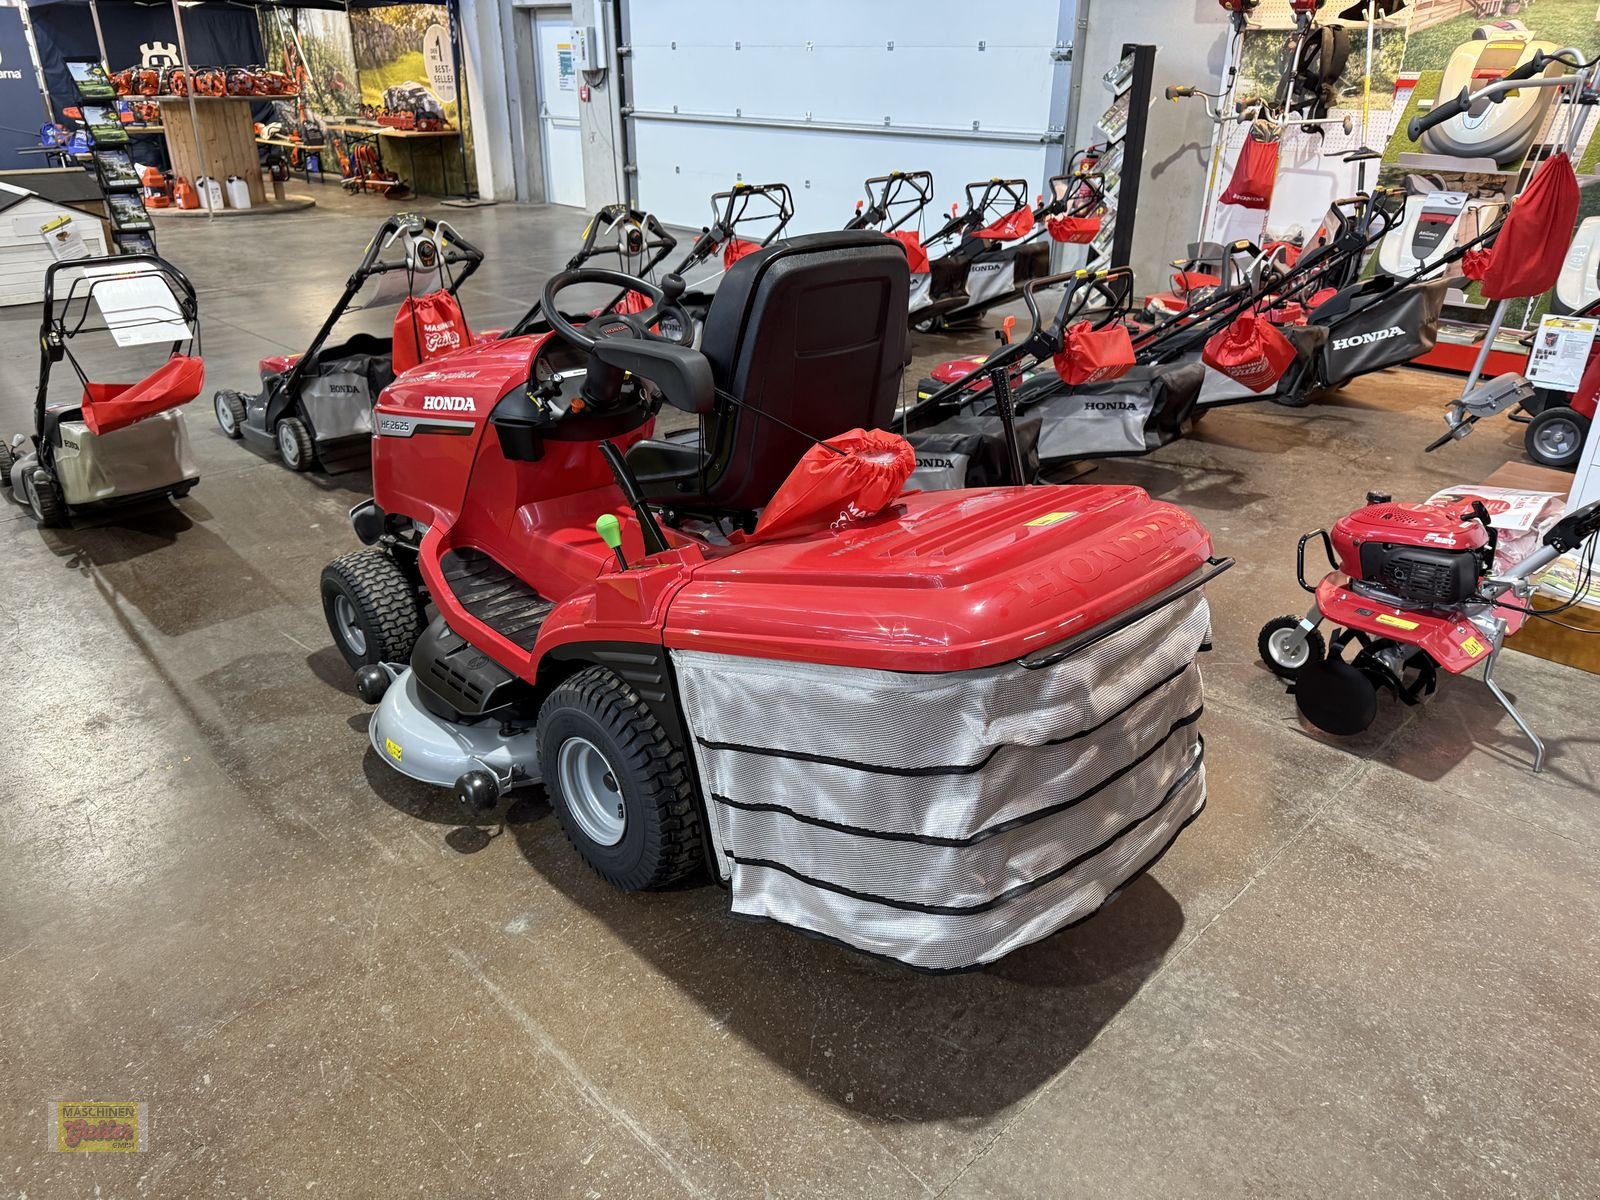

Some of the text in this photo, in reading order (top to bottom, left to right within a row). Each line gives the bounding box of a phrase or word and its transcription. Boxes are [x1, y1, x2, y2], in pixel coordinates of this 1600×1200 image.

[1332, 326, 1406, 350] HONDA
[330, 384, 360, 393] HONDA
[423, 396, 476, 411] HONDA
[1084, 402, 1138, 411] HONDA
[381, 420, 409, 431] HF2625
[915, 458, 954, 468] ONDA
[1009, 518, 1189, 608] HONDA
